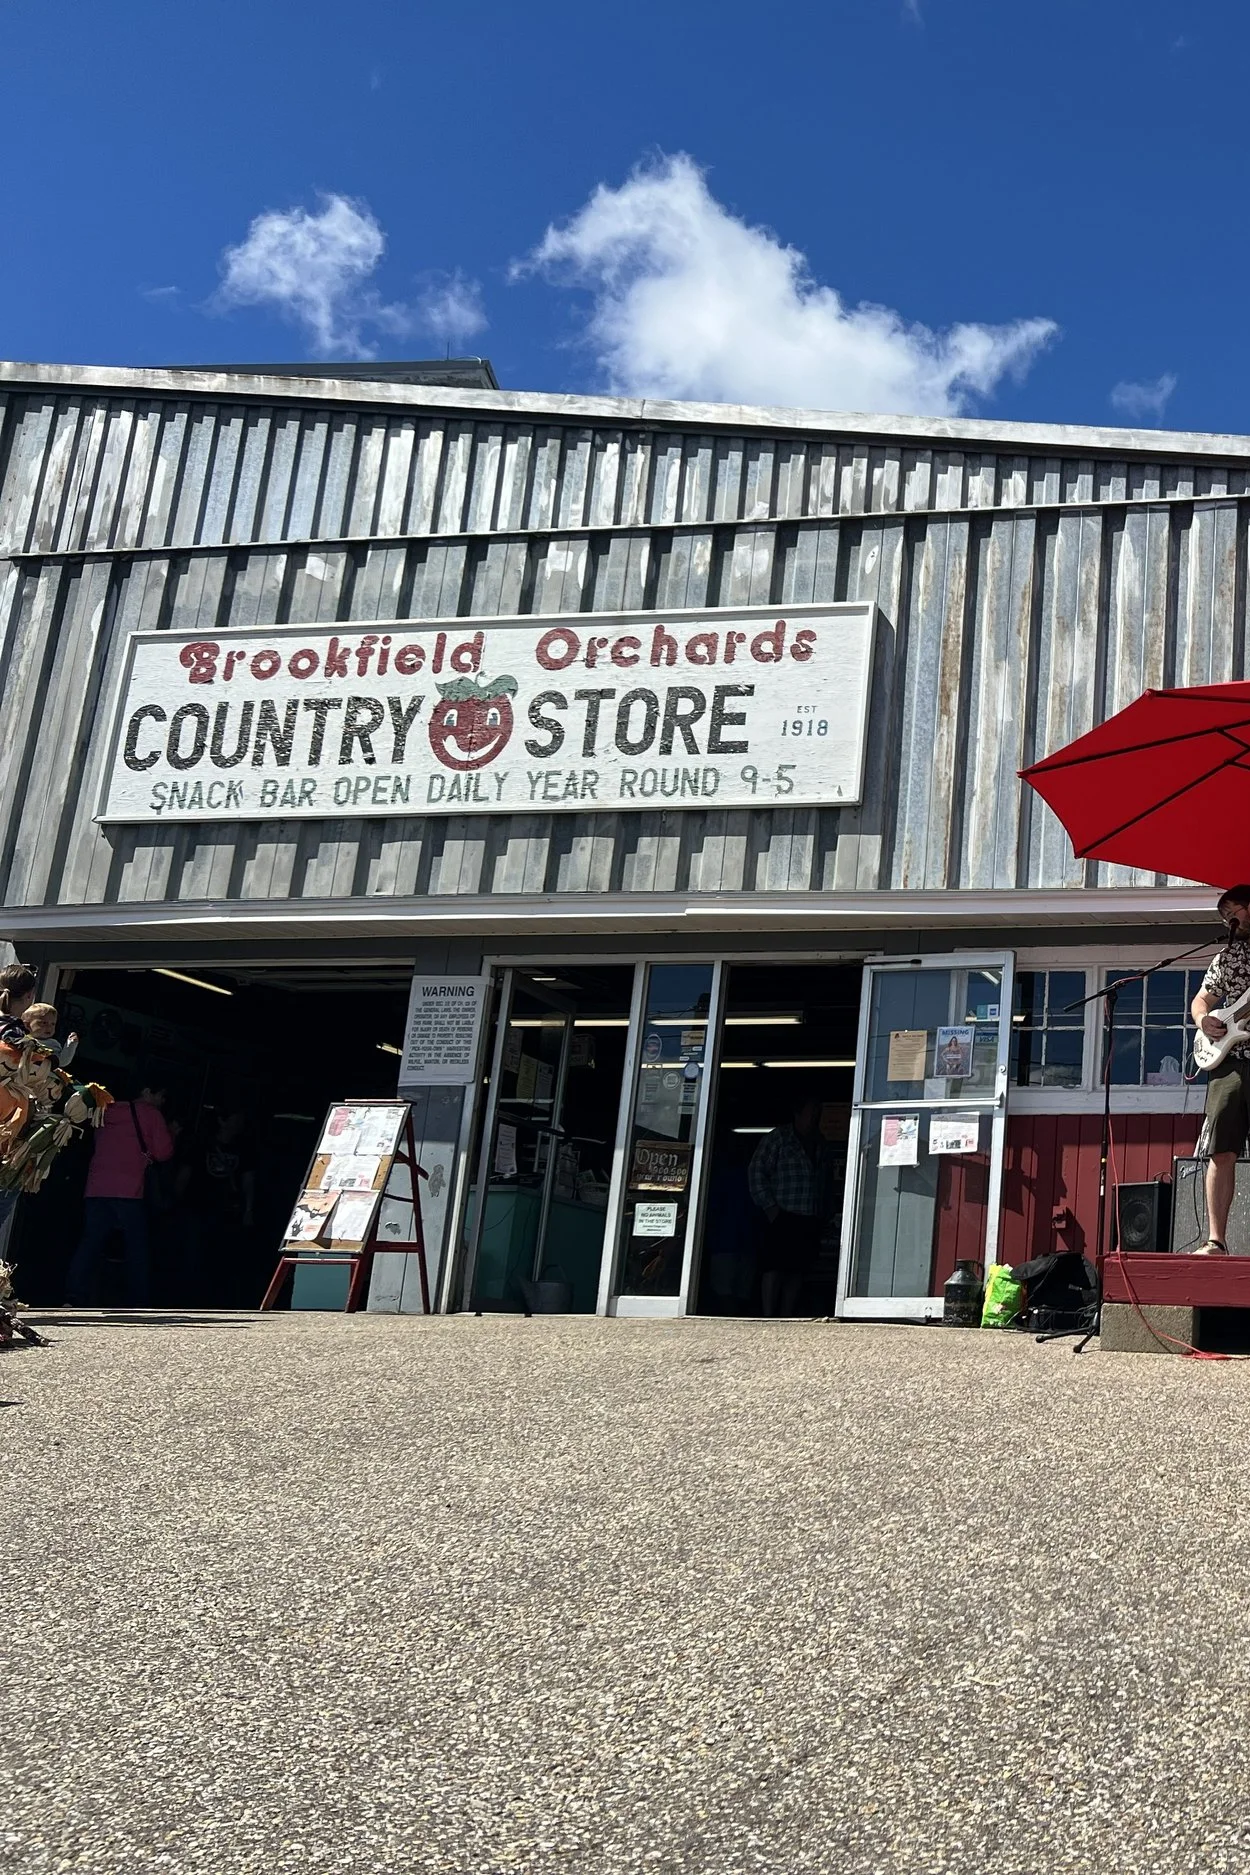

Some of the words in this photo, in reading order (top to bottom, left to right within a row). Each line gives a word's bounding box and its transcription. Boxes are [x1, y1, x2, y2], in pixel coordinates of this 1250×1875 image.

[178, 631, 485, 685] Brookfield
[535, 619, 817, 670] Orchards
[797, 705, 818, 714] EST
[123, 694, 426, 772] COUNTRY
[524, 684, 755, 759] STORE
[780, 720, 829, 738] 1918
[149, 780, 245, 815] SNACK
[259, 777, 318, 809] BAR
[333, 775, 412, 806] OPEN
[428, 772, 508, 803] DAILY
[525, 769, 600, 801] YEAR
[619, 766, 721, 798] ROUND
[740, 763, 795, 795] 9-5
[422, 986, 475, 997] WARNING
[637, 1148, 679, 1170] Open
